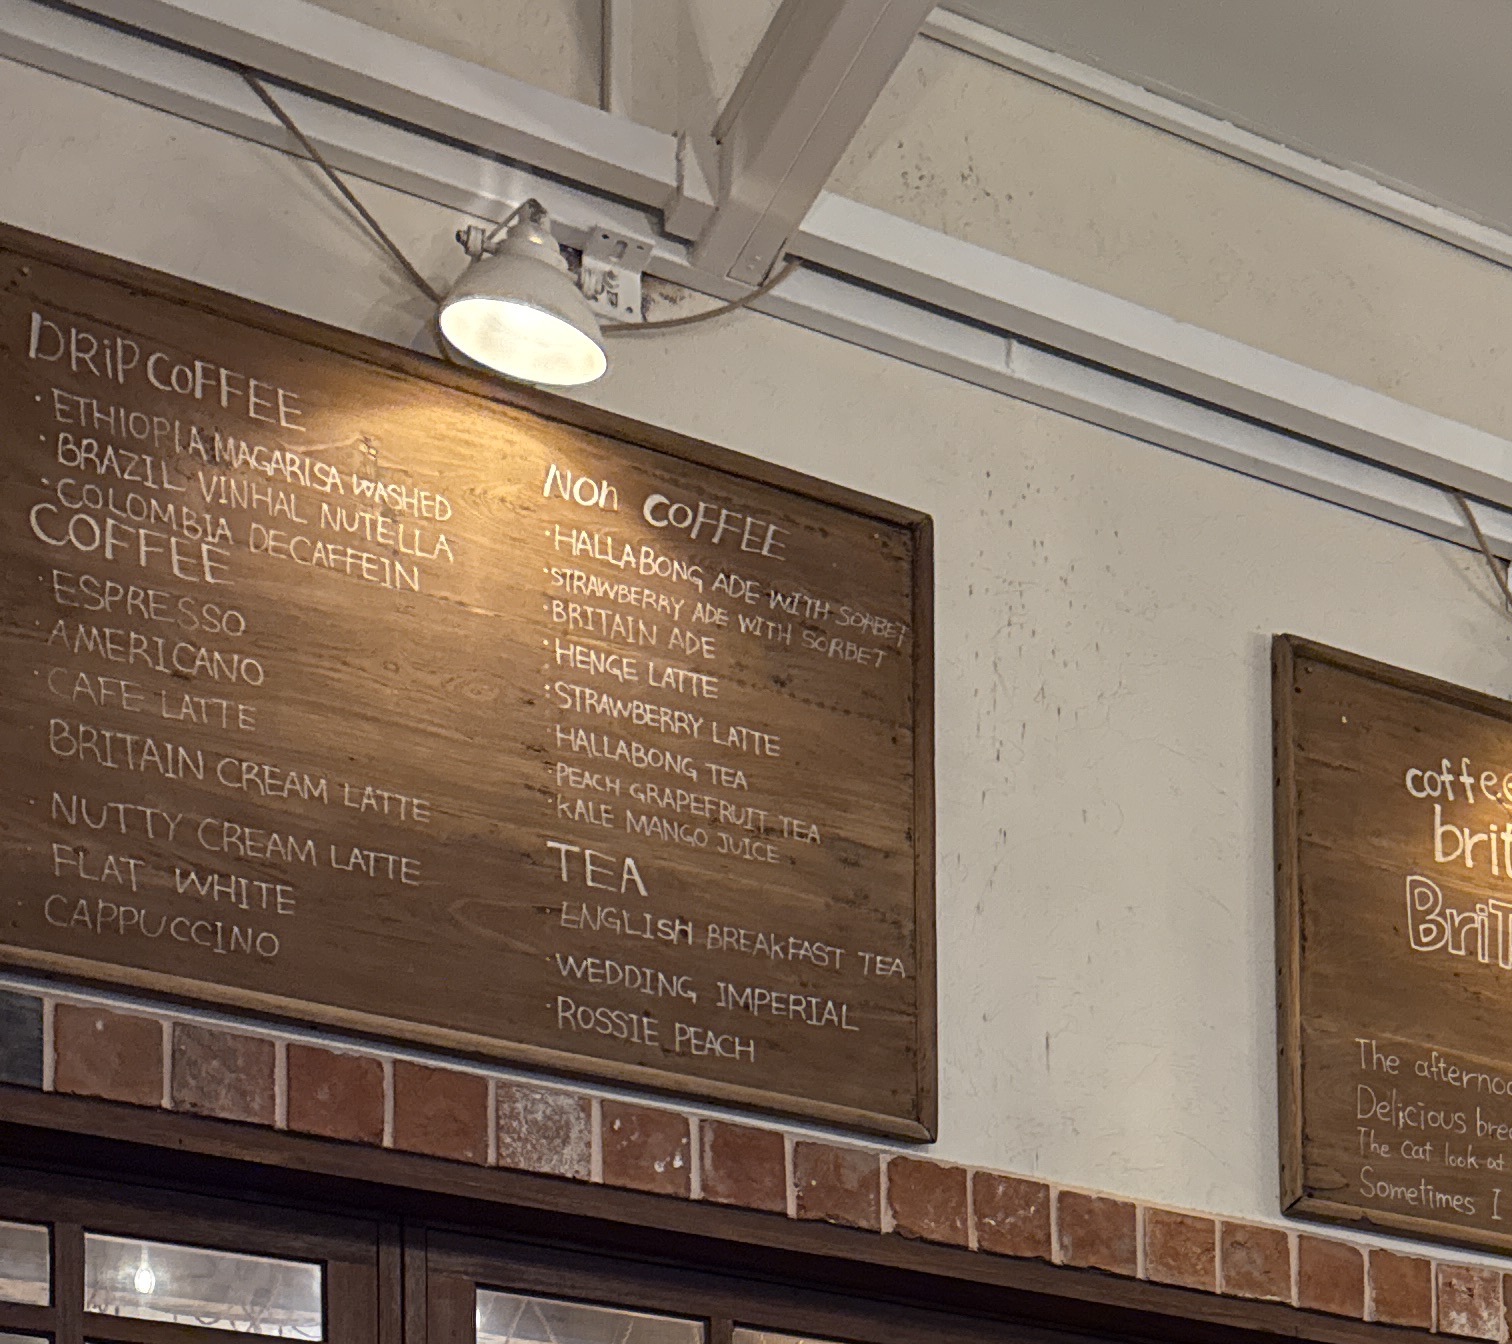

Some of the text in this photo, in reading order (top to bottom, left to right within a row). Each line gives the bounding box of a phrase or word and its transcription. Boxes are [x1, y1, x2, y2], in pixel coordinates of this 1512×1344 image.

[52, 388, 452, 521] ETHIOPIA MAGARISA WASHED
[57, 433, 454, 563] BRAZIL VINHAL NUTELLA
[30, 503, 234, 584] COFFEE
[57, 478, 420, 591] COLOMBIA DECAFFEIN
[52, 570, 246, 636] ESPRESSO
[551, 568, 887, 667] STRAWBERRY ADE WITH SORBET
[555, 524, 910, 647] HALLABONG ADE WITH SORBET
[47, 620, 264, 686] AMERICANO
[552, 600, 716, 659] BRITAIN ADE
[48, 668, 256, 730] CAFE LATTE
[556, 639, 719, 698] HENGE LATTE
[555, 682, 781, 756] STRAWBERRY LATTE
[50, 719, 431, 823] BRITAIN CREAM LATTE
[557, 724, 748, 790] HALLABONG TEA
[557, 763, 821, 844] PEACH GRAPEFRUIT TEA
[626, 810, 707, 847] MANGO
[717, 832, 781, 863] JUICE
[52, 793, 420, 886] NUTTY CREAM LATTE
[547, 841, 648, 896] TEA
[52, 843, 296, 914] FLAT WHITE
[44, 895, 279, 957] CAPPUCCINO
[561, 902, 905, 978] ENGLISH BREAKFAST TEA
[556, 954, 859, 1030] WEDDING IMPERIAL
[558, 997, 754, 1062] ROSSIE PEACH
[1355, 1038, 1400, 1074] The
[1357, 1084, 1466, 1134] Delicious
[1357, 1127, 1390, 1157] The
[1445, 1143, 1477, 1169] look
[1486, 1153, 1503, 1171] at
[1360, 1167, 1475, 1215] Sometimes
[1491, 1189, 1502, 1221] I
